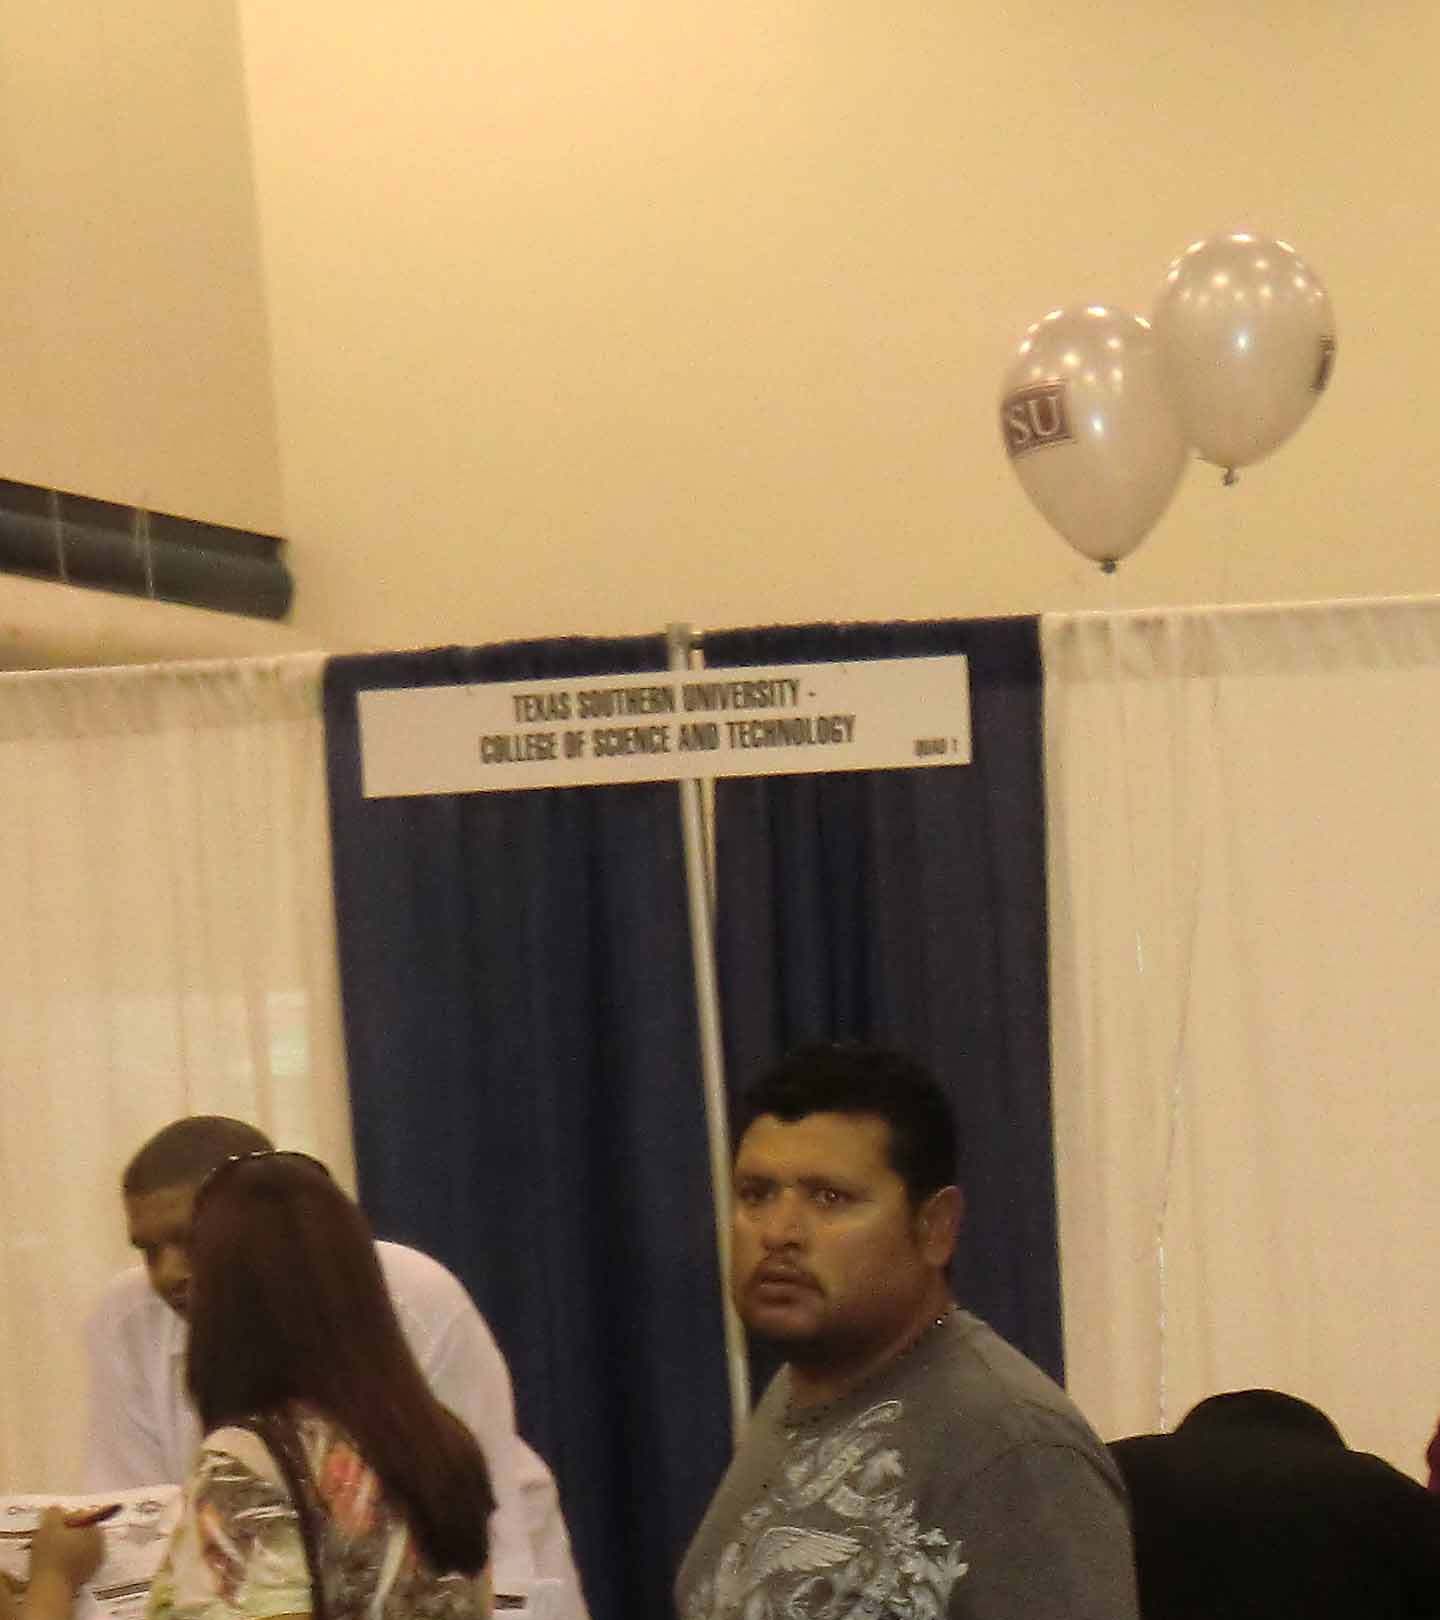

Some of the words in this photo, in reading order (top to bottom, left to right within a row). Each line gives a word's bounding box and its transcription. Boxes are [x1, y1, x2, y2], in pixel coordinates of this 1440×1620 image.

[512, 691, 572, 723] TEXAS
[578, 686, 676, 720] SOUTHERN
[682, 678, 798, 713] UNIVERSITY
[480, 731, 559, 765] COLLEGE
[566, 730, 586, 760] OF
[593, 724, 671, 758] SCIENCE
[679, 722, 719, 751] AND
[724, 715, 854, 750] TECHNOLOGY
